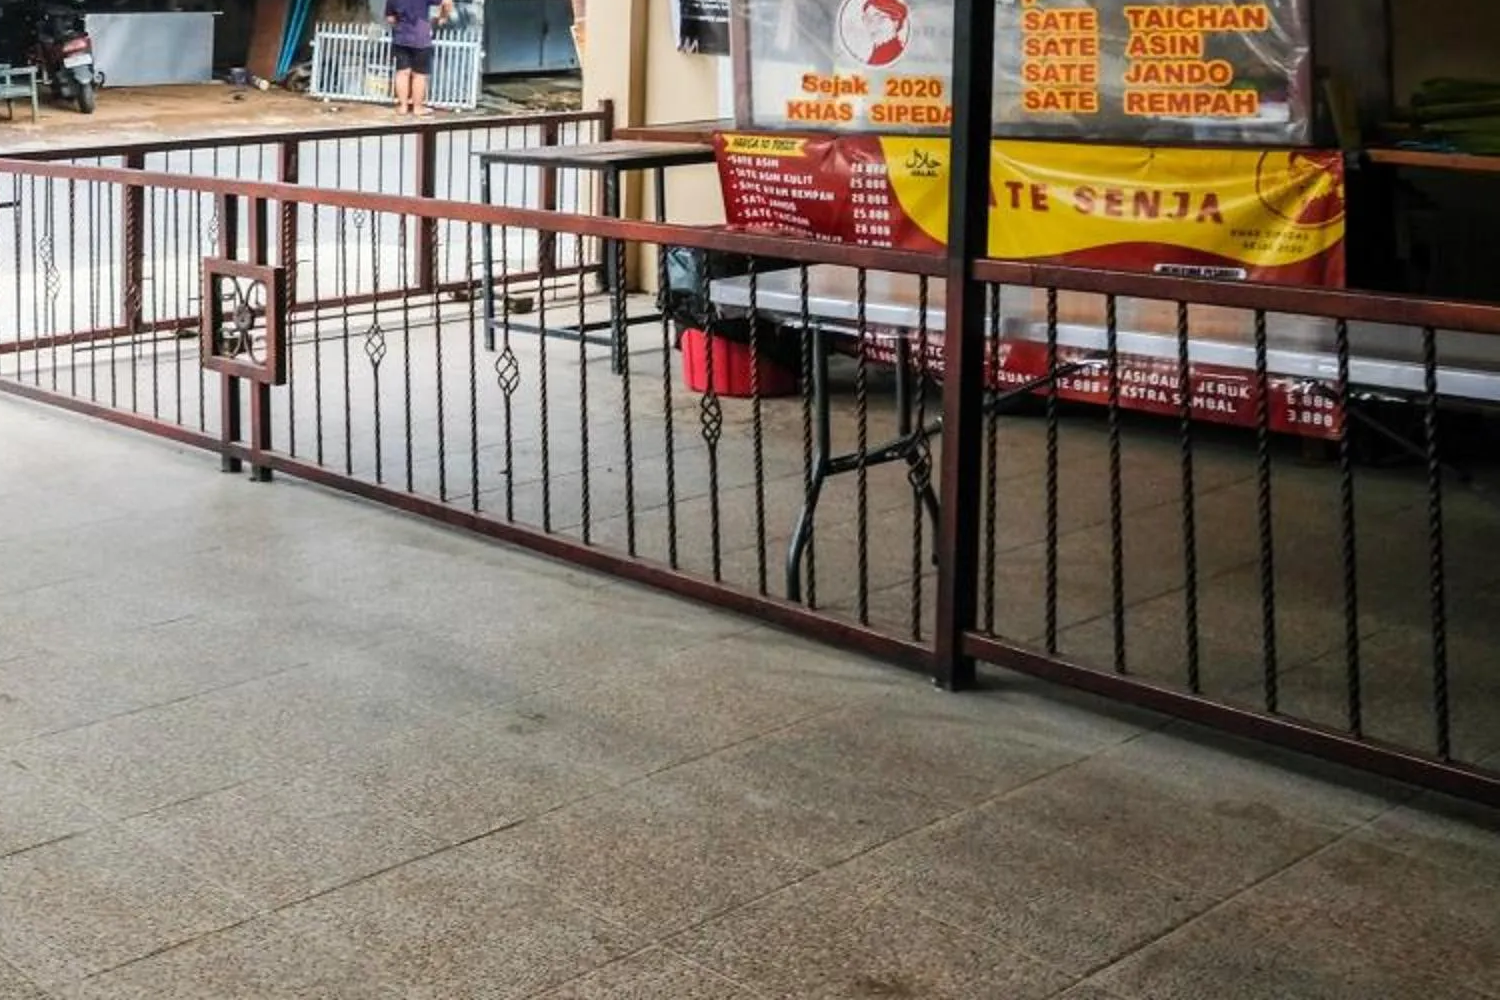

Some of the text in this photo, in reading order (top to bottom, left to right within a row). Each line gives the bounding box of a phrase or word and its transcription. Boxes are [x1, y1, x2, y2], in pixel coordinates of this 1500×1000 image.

[1023, 5, 1267, 34] SATE TAICHAN
[1023, 33, 1203, 59] SATE ASIN
[1023, 59, 1233, 86] SATE JANDO
[801, 74, 944, 99] Sejak 2020
[786, 101, 952, 126] KHAS SIPEDA
[1023, 88, 1258, 116] SATE REMPAH
[904, 147, 942, 170] حلال
[1074, 184, 1224, 225] SENJA
[1118, 383, 1168, 403] KSTRA
[1173, 391, 1237, 414] SMBAL
[1197, 380, 1251, 400] JERUK
